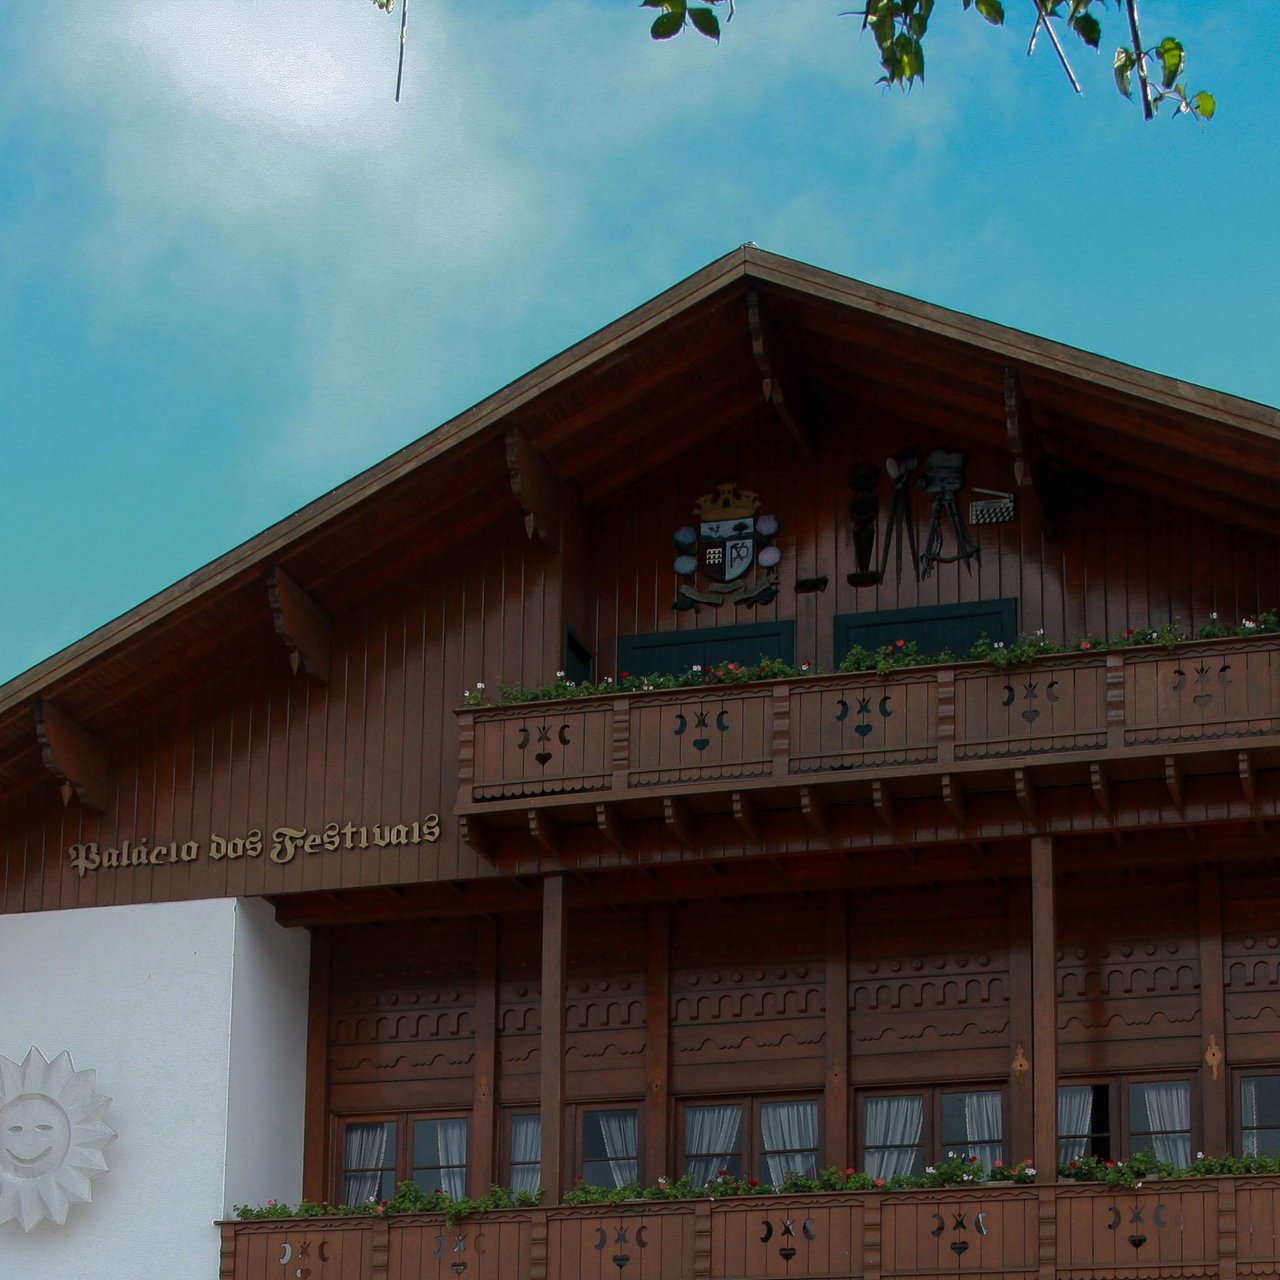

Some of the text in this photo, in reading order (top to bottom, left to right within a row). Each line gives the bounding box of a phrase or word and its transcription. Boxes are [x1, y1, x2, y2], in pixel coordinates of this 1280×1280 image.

[67, 813, 441, 877] Palácio dos Festivais
